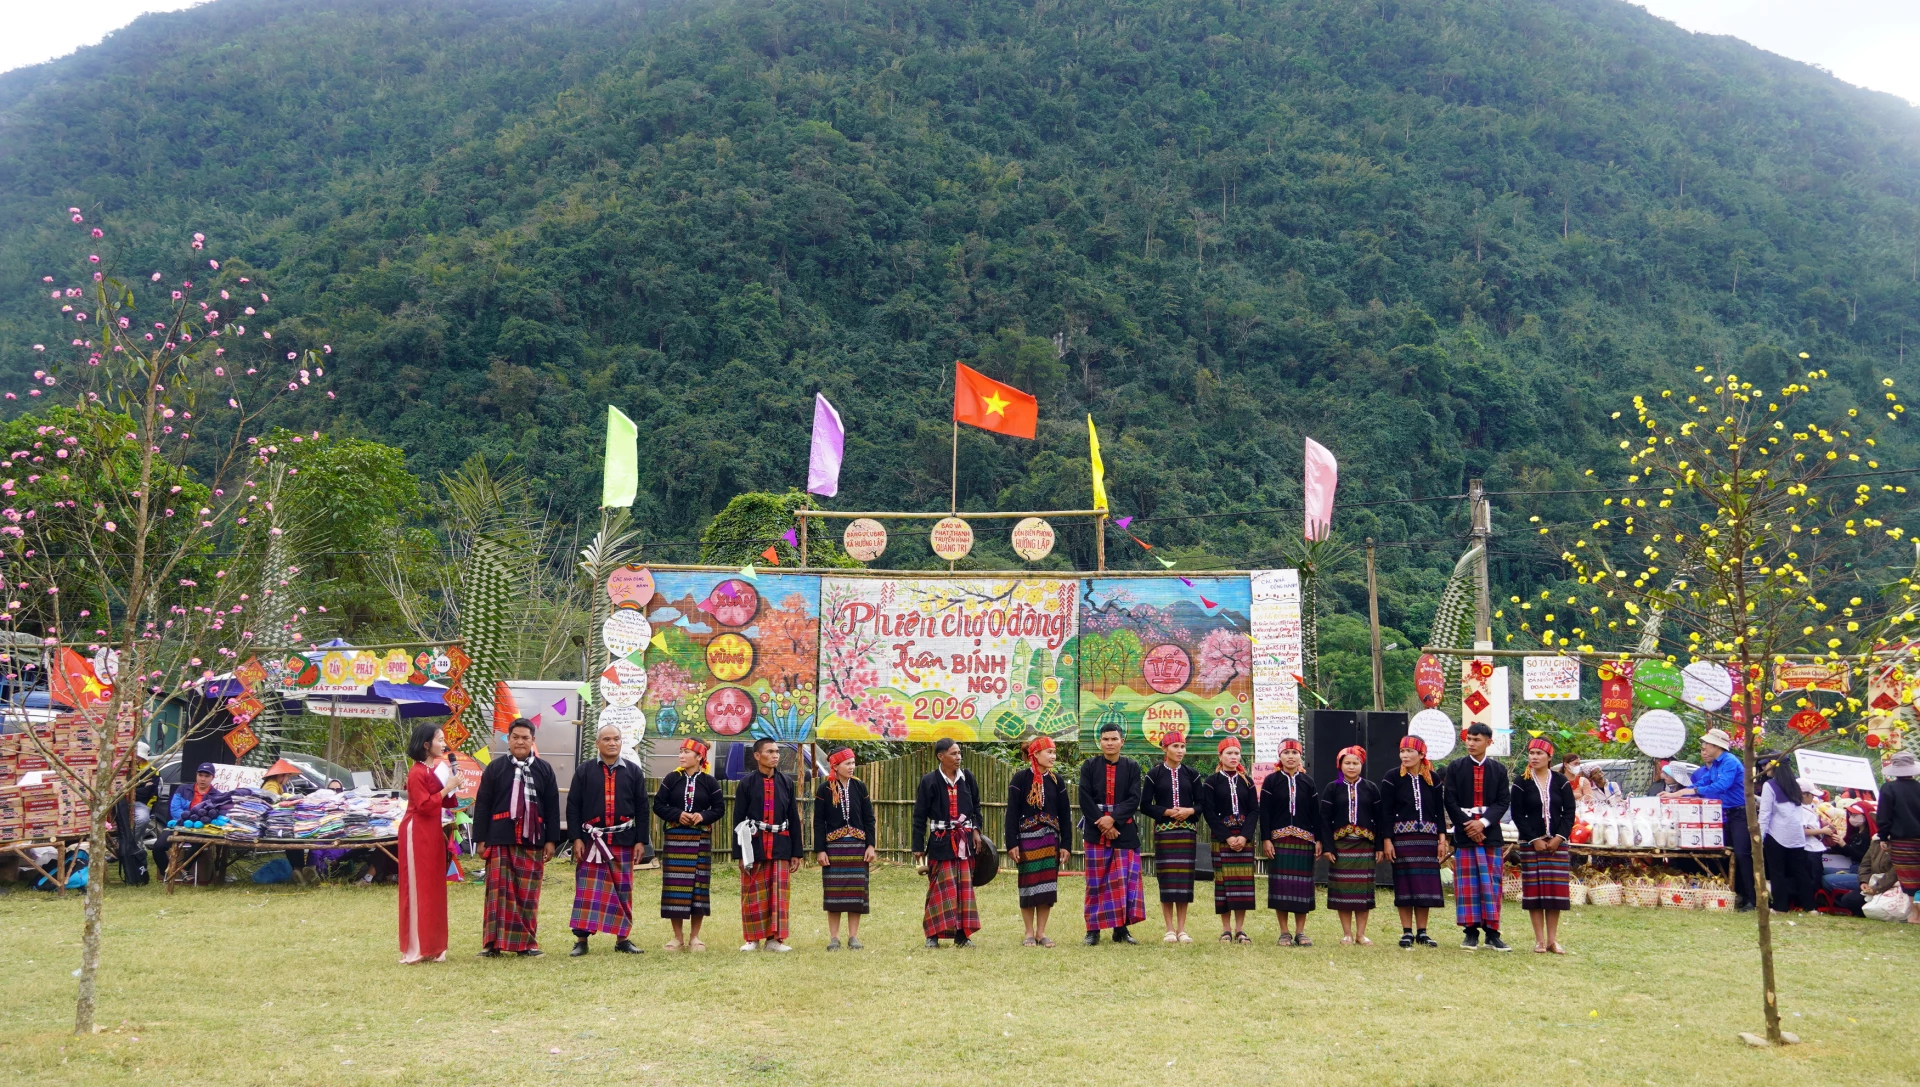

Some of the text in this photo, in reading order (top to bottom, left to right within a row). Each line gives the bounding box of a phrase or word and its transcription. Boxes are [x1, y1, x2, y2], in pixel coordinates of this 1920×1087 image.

[716, 588, 756, 608] XUÂN
[839, 601, 938, 638] Phiên
[709, 648, 745, 665] VÙNG
[892, 640, 947, 683] Xuân
[951, 649, 1006, 675] BÍNH
[1147, 649, 1188, 678] TẾT
[355, 661, 374, 675] PHÁT
[388, 661, 408, 673] SPORT
[966, 676, 1007, 700] NGỌ
[713, 703, 745, 716] CAO
[912, 696, 977, 721] 2026
[1147, 704, 1183, 720] BÍNH
[1603, 698, 1629, 709] 2026
